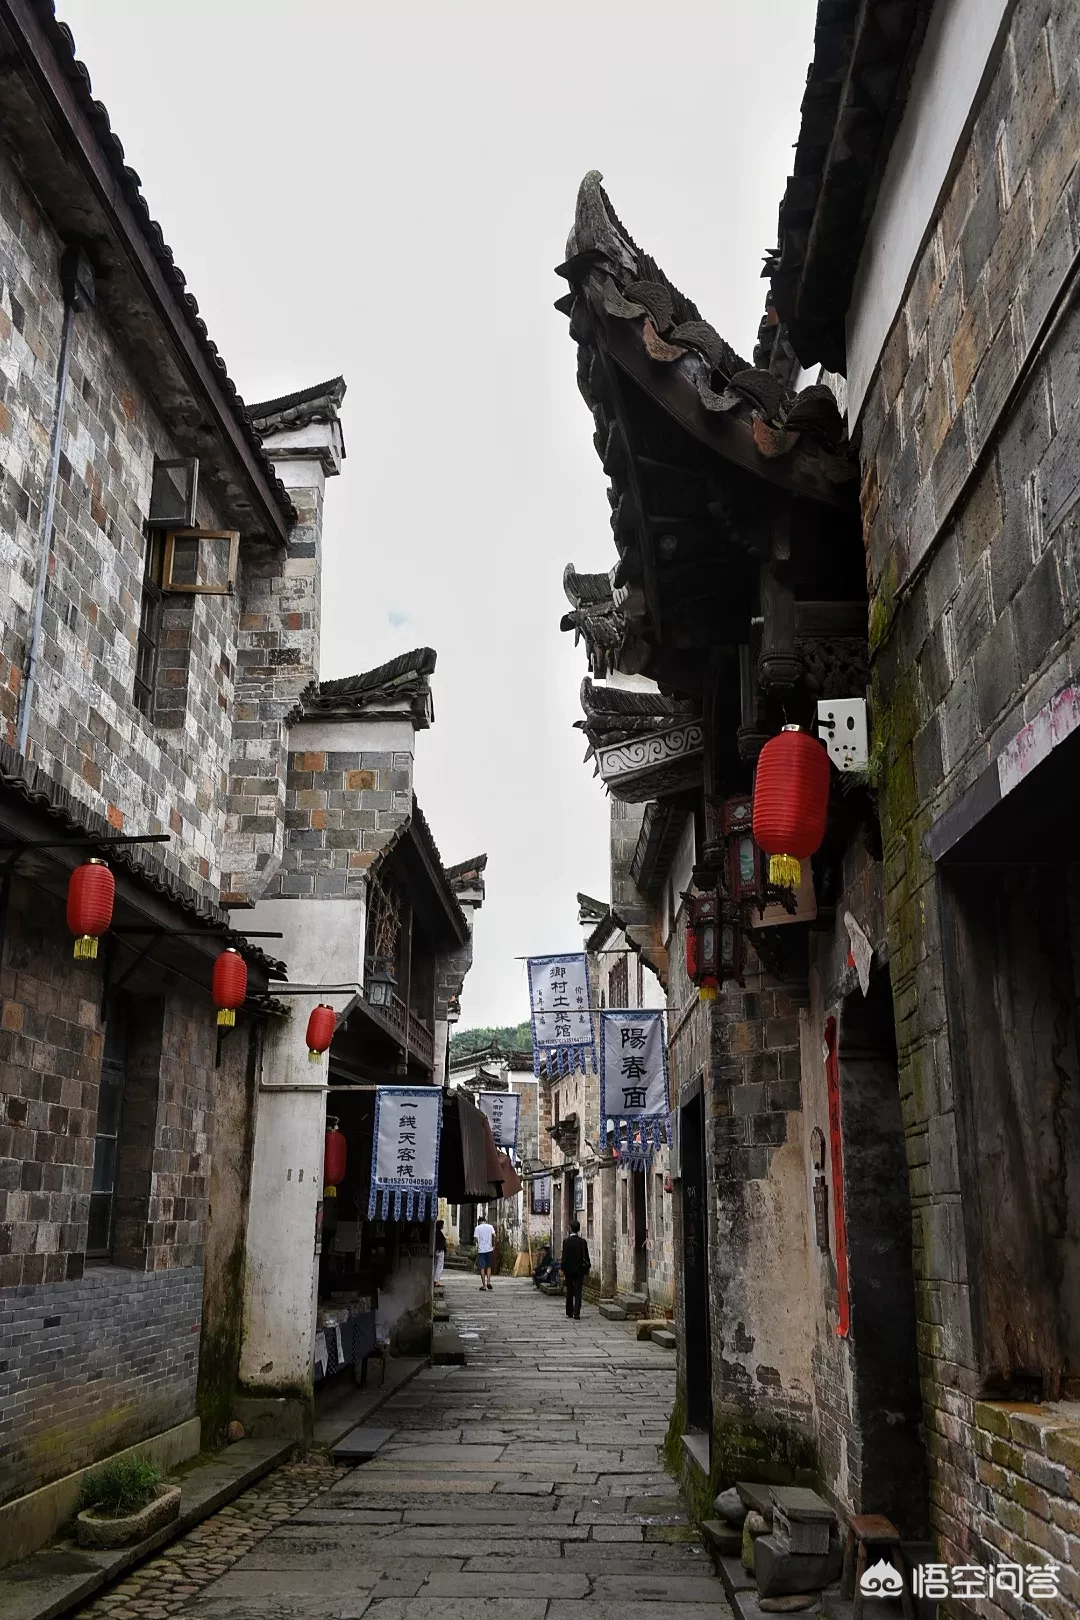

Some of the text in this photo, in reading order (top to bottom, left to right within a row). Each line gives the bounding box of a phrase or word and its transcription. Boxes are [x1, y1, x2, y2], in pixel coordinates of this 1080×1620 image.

[620, 1027, 649, 1109] 陽春面
[396, 1102, 419, 1178] 一线天客栈
